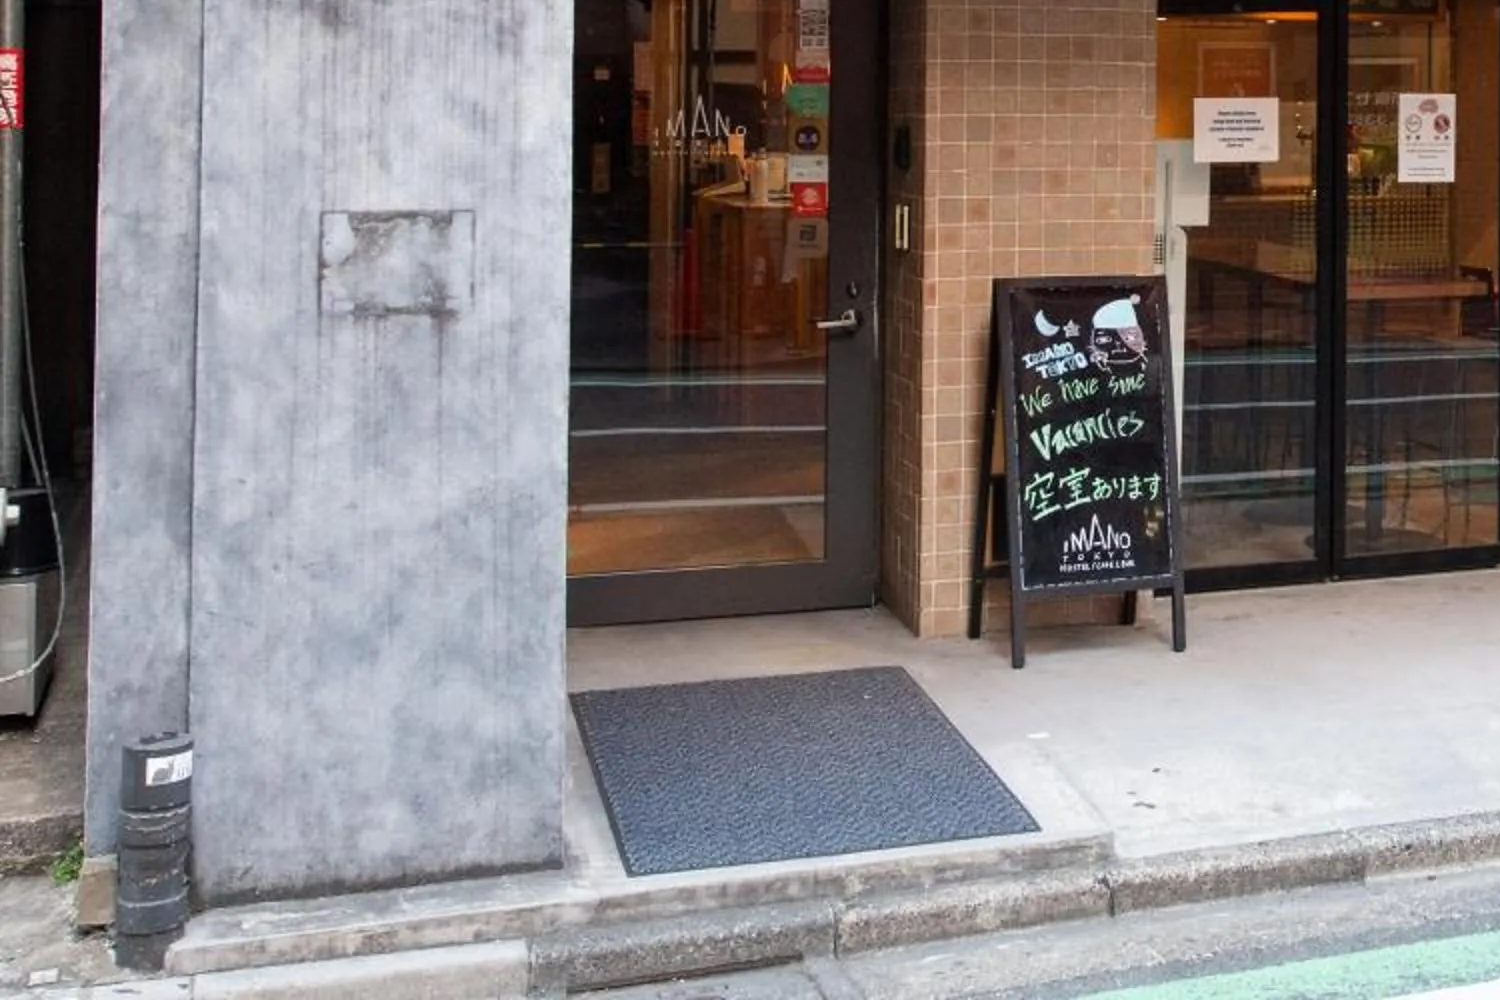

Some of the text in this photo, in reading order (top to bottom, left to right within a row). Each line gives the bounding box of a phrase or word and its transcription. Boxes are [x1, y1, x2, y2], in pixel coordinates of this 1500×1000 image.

[1020, 385, 1052, 417] We
[1059, 377, 1099, 403] have
[1030, 408, 1145, 461] Vacancies
[1023, 467, 1163, 521] 空室あります
[1063, 512, 1131, 553] IMANO
[1062, 550, 1131, 563] TOKYO
